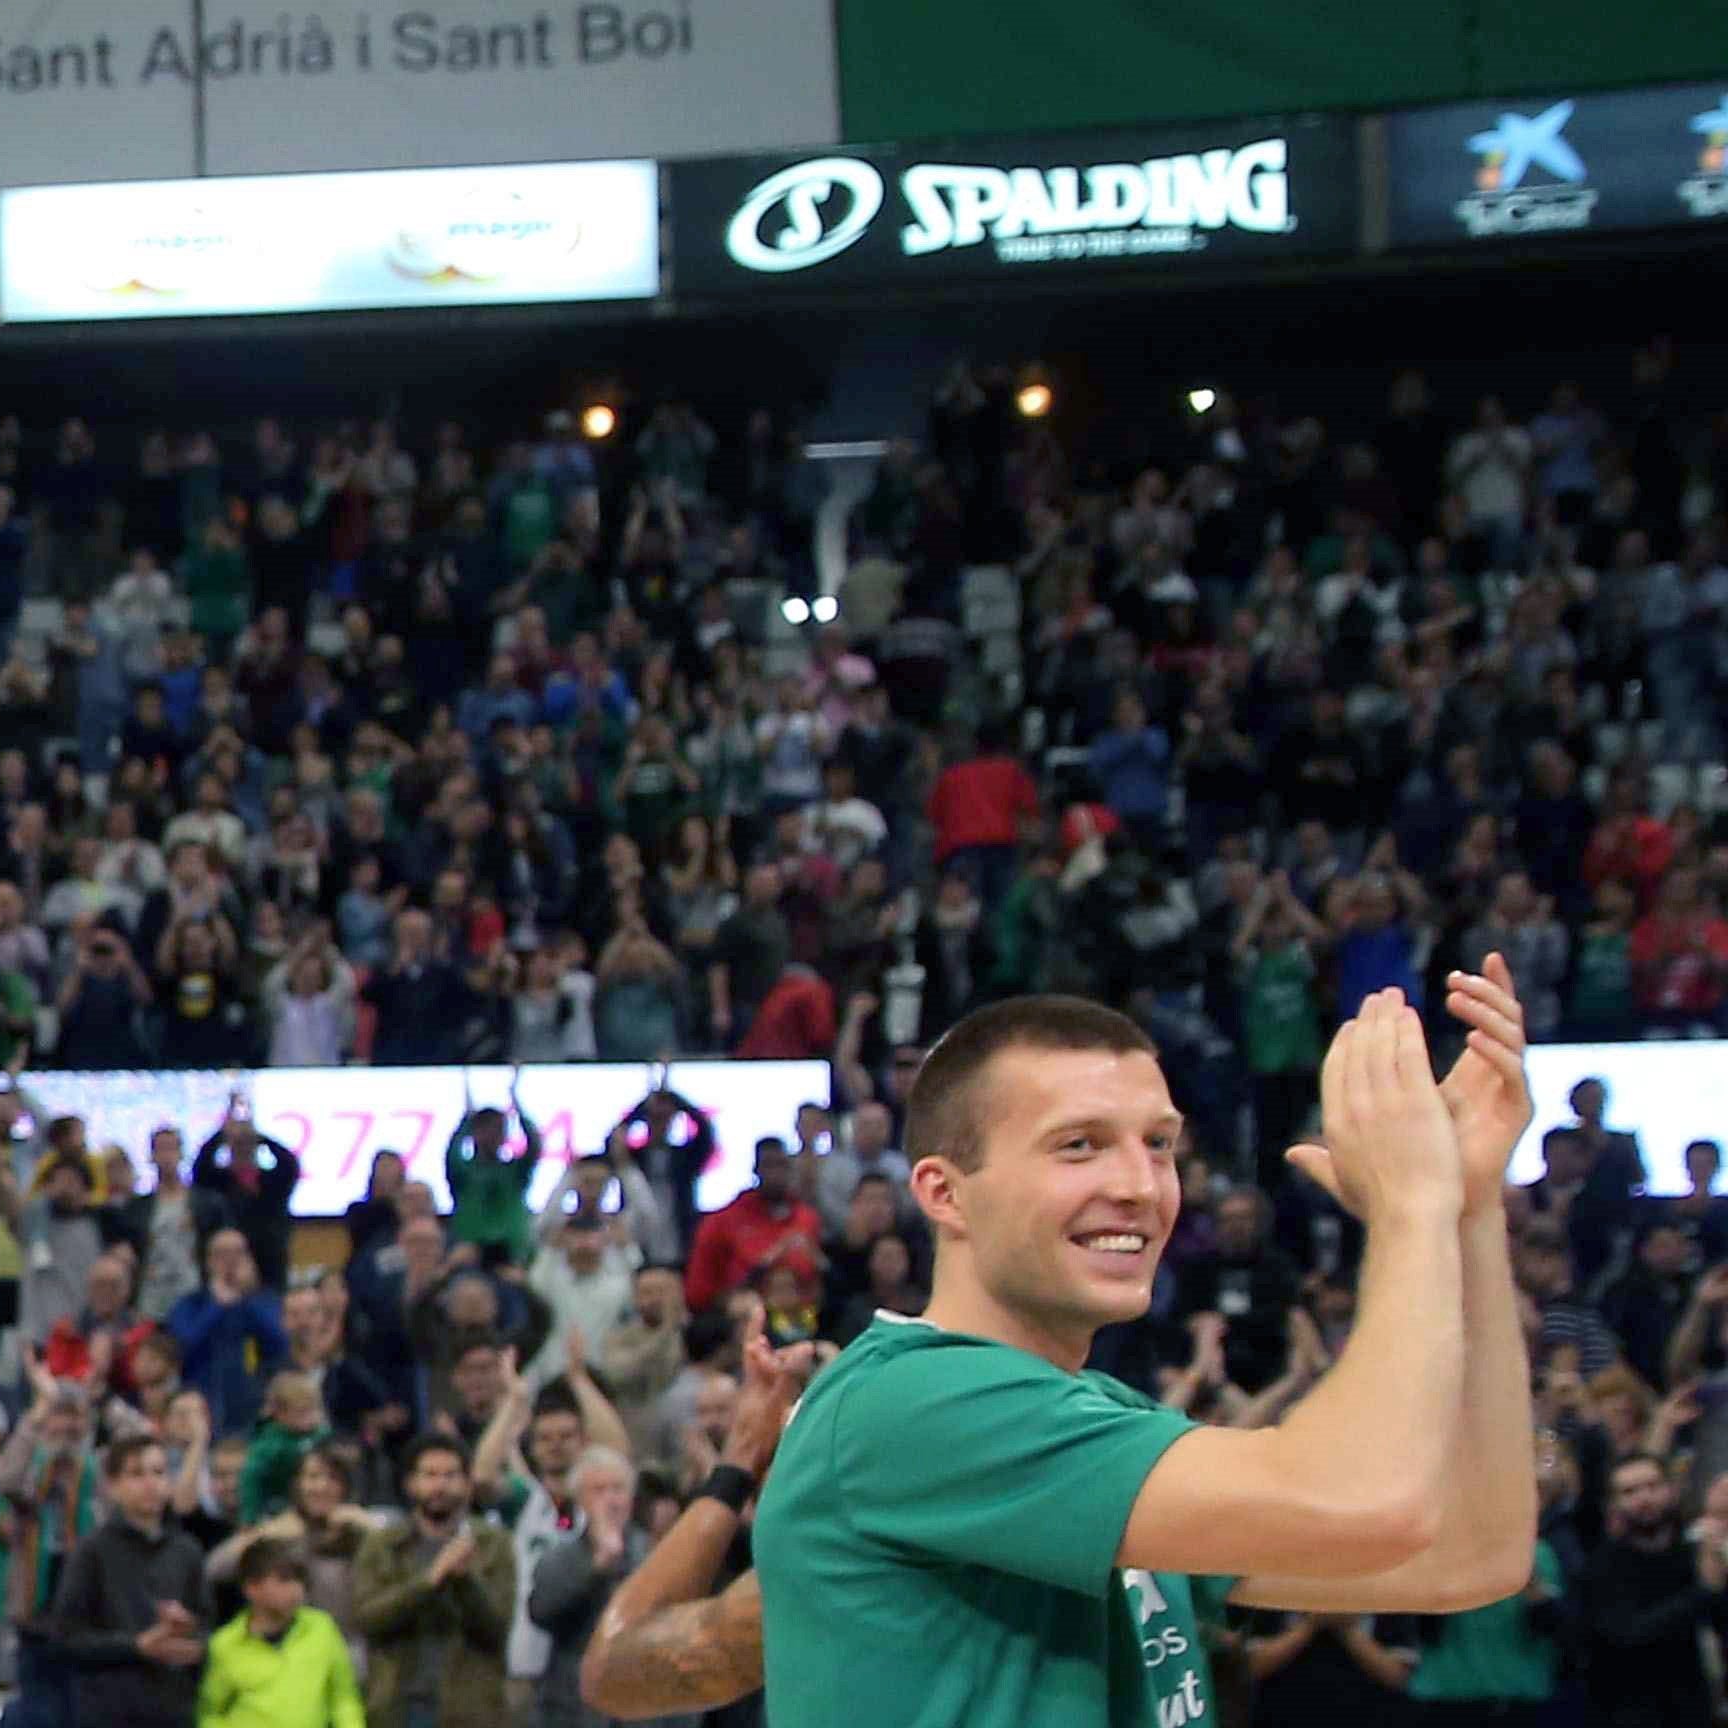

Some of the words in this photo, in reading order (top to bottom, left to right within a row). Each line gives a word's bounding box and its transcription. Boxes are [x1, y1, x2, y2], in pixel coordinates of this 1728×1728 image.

[144, 17, 336, 85] Adrià
[355, 24, 372, 70] i
[390, 13, 556, 73] Sant
[576, 1, 695, 63] Boi
[901, 139, 1288, 256] SPALDING
